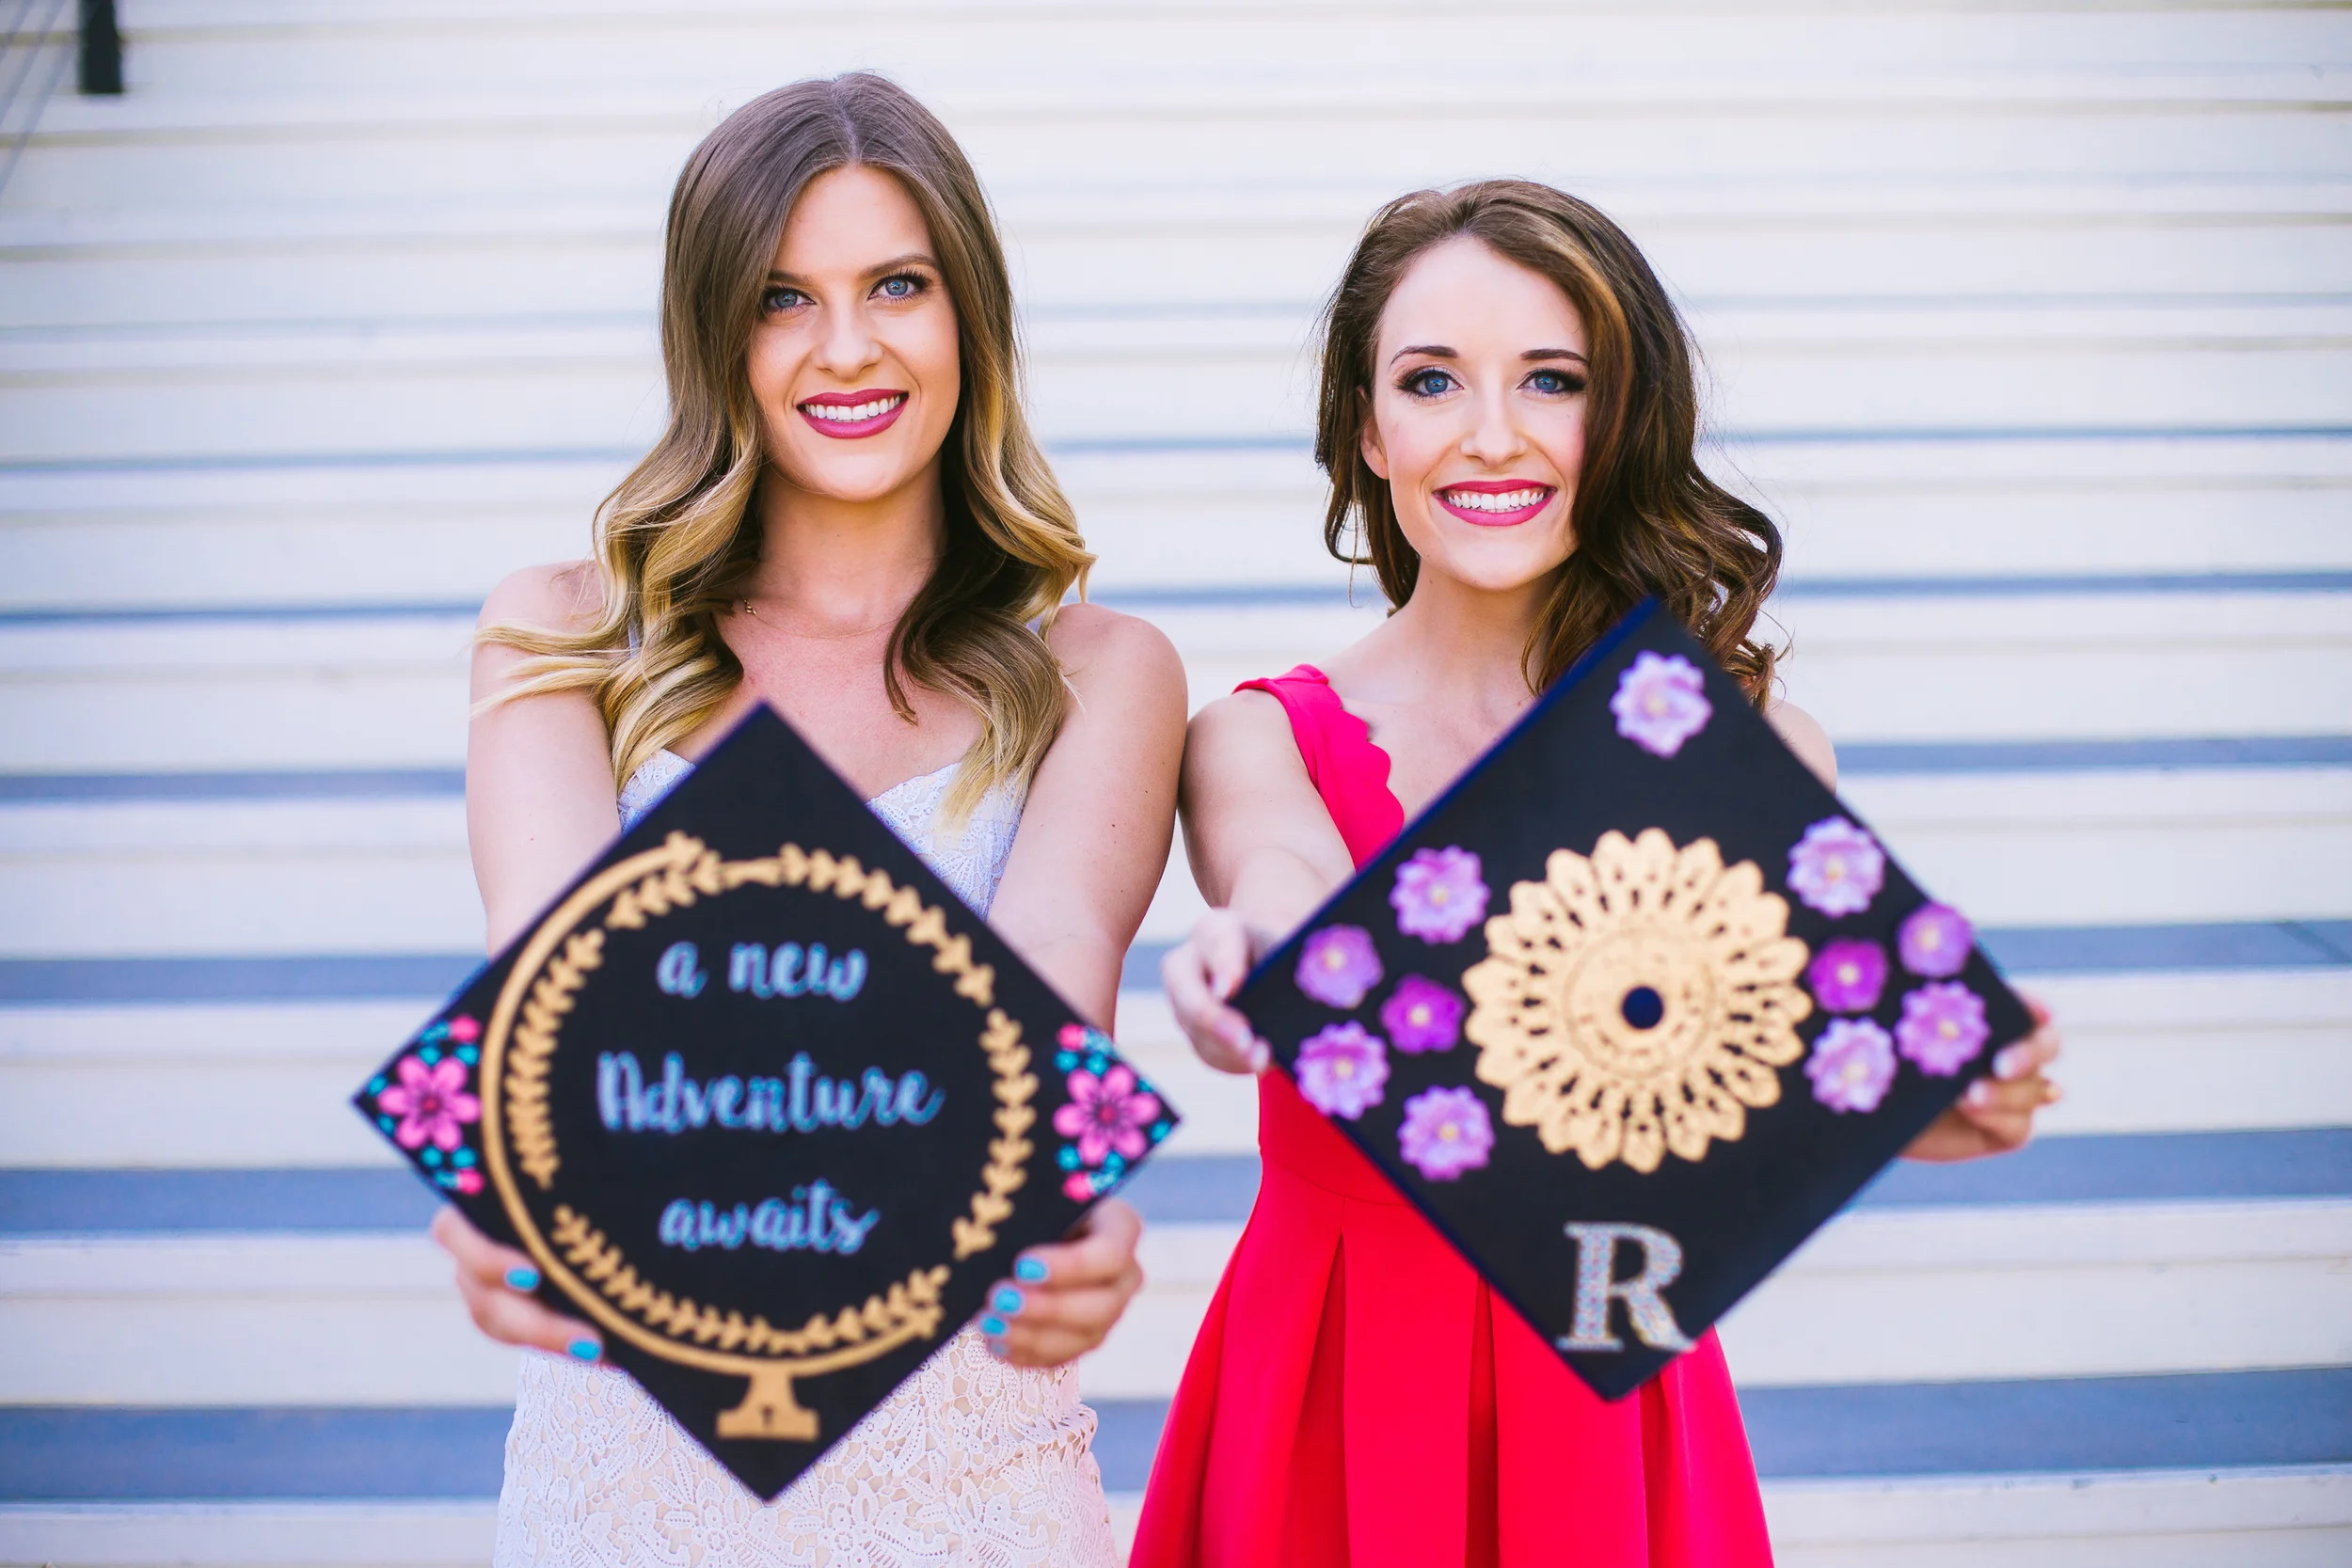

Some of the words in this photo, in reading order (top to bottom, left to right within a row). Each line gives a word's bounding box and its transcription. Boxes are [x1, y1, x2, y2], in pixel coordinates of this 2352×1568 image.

[657, 941, 709, 999] a
[727, 941, 868, 1003] new
[596, 1050, 945, 1133] Adventure
[659, 1178, 881, 1255] awaits
[1556, 1221, 1696, 1352] R
